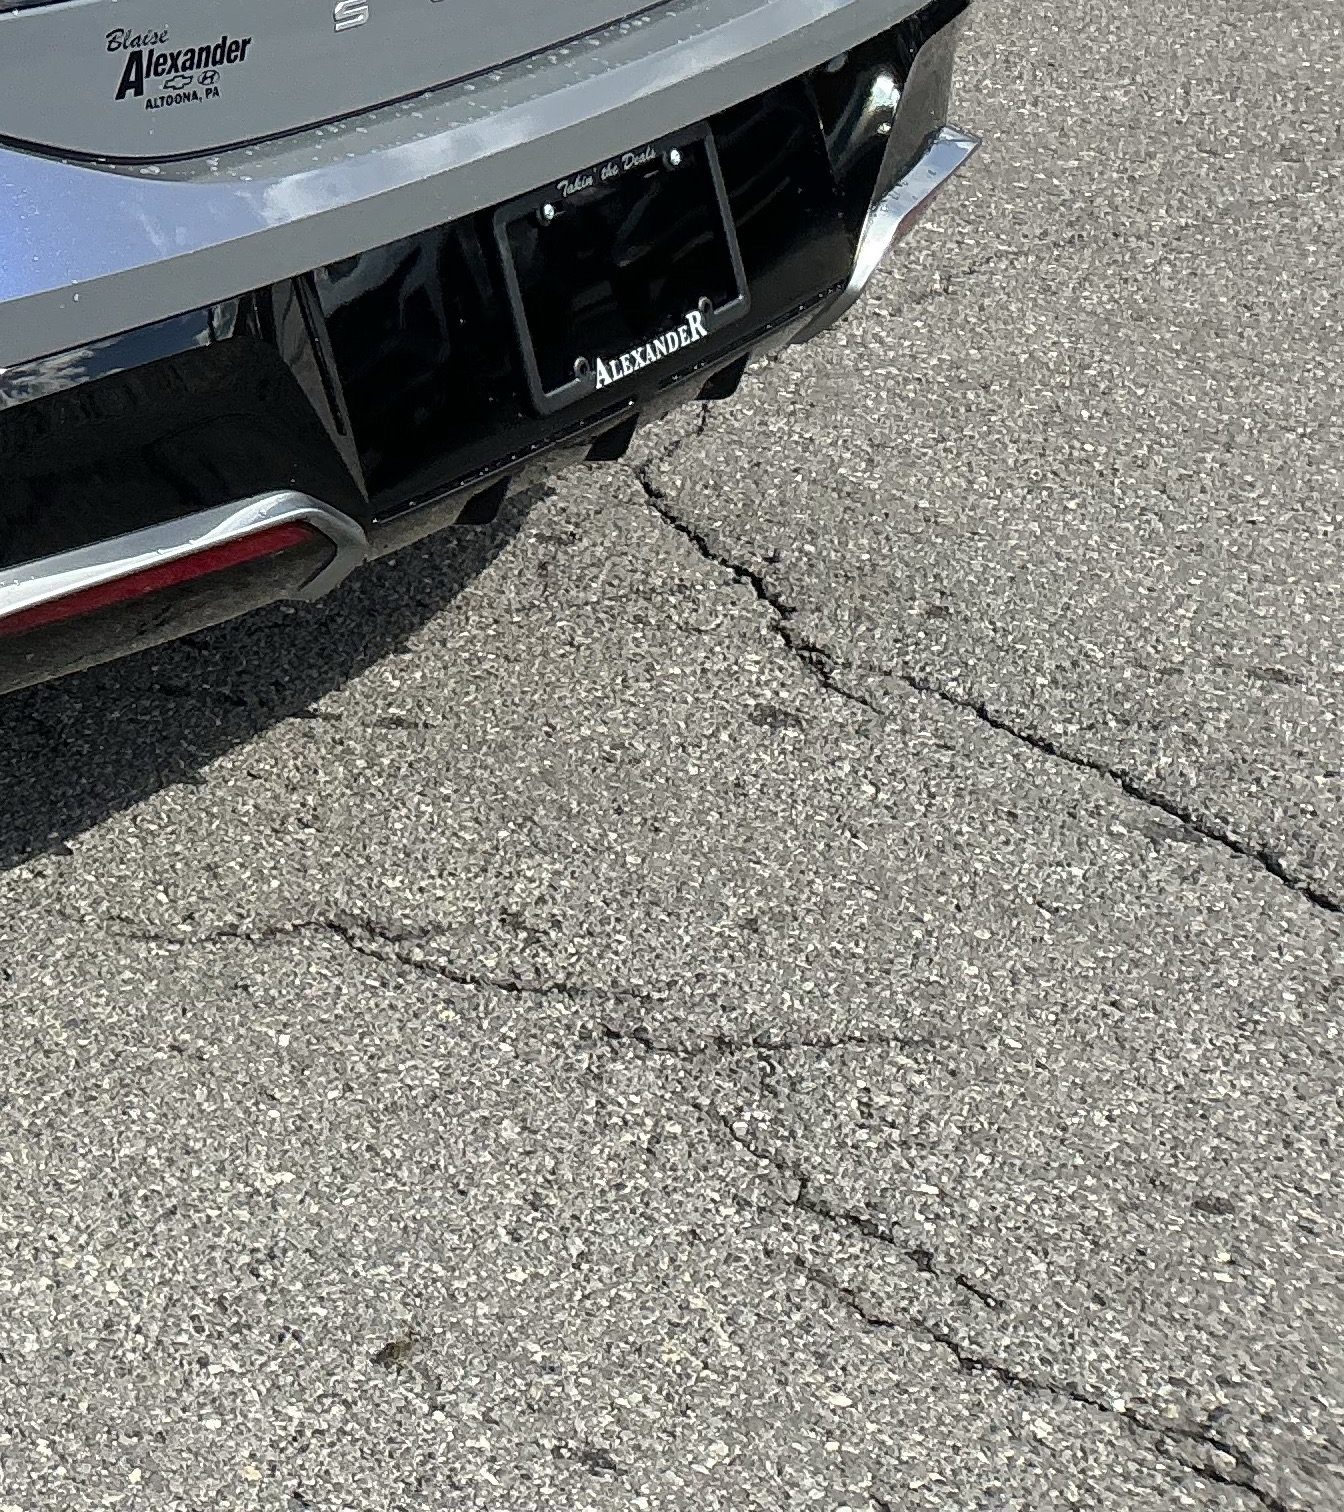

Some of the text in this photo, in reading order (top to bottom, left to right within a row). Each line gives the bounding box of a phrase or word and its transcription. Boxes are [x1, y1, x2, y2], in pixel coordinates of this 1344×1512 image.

[105, 28, 169, 52] Blaise
[115, 36, 252, 100] Alexander
[145, 86, 220, 110] ALTOONA, PA
[601, 162, 619, 180] the
[622, 145, 657, 170] Deals
[595, 309, 707, 388] ALEXANDER
